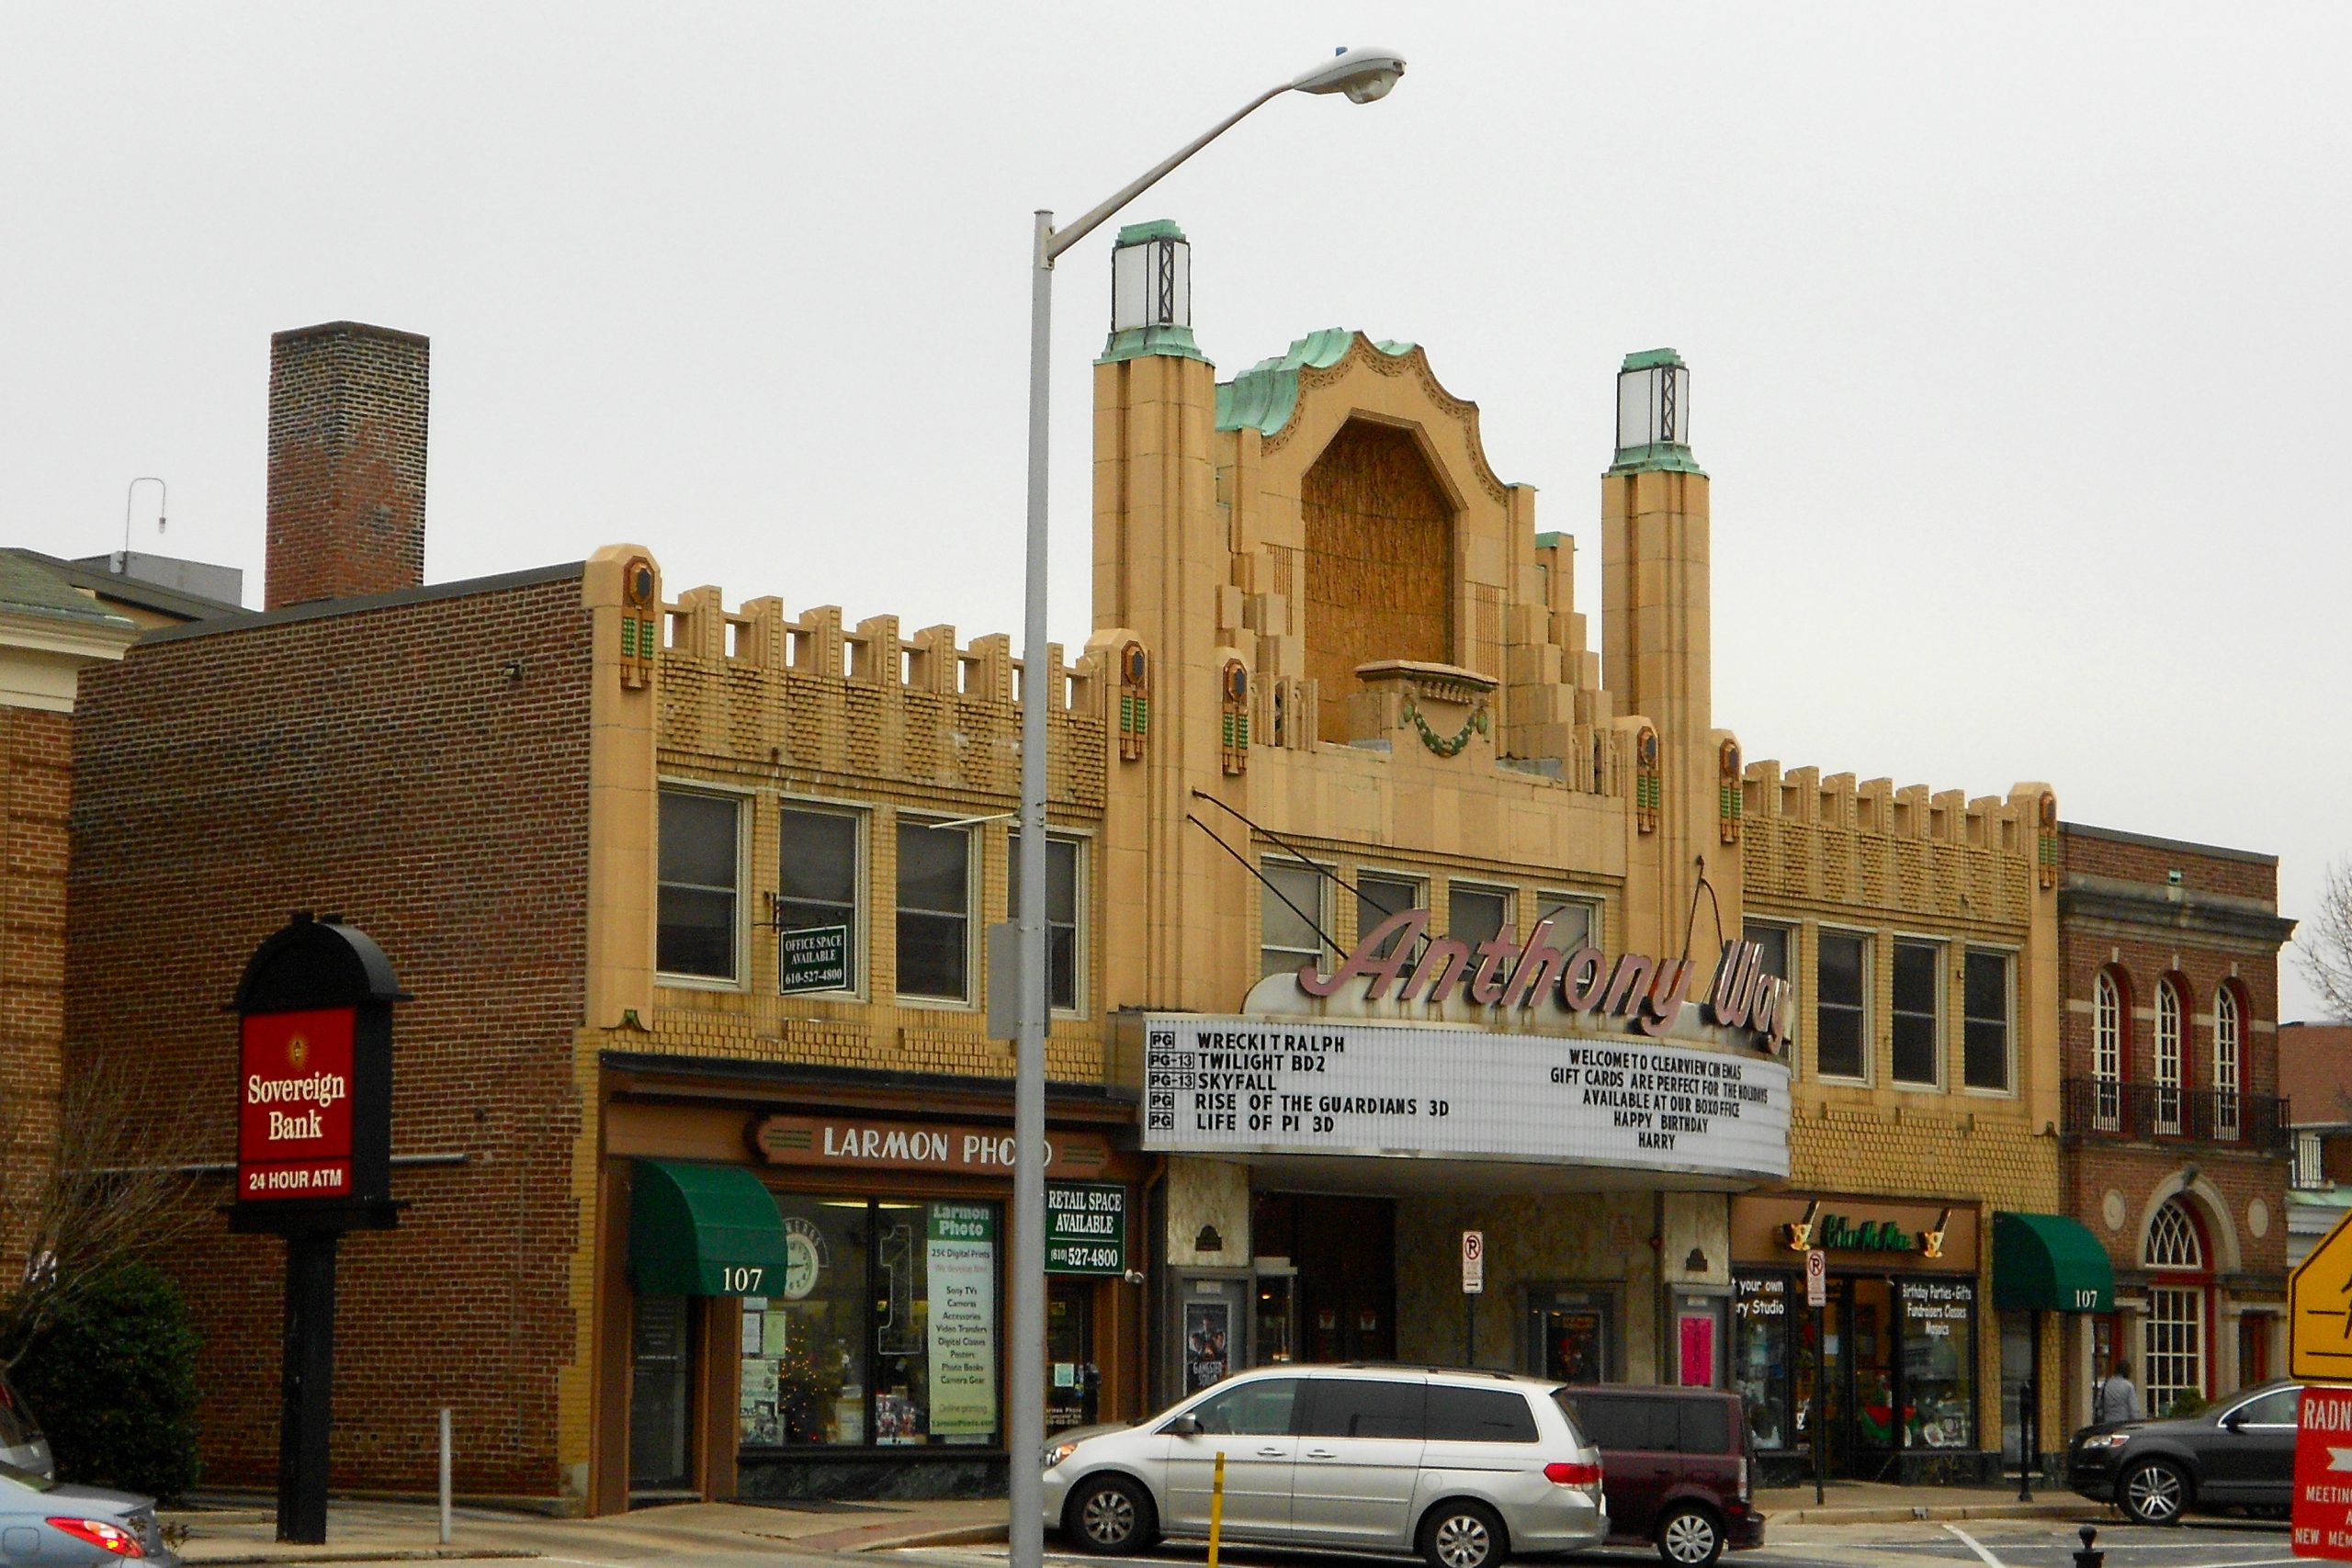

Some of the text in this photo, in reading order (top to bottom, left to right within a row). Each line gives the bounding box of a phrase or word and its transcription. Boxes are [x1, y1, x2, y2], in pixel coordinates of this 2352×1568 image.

[786, 935, 842, 952] OFFICE SPACE
[791, 949, 836, 964] AVAILABLE
[785, 968, 842, 985] 610-527-4800
[1297, 908, 1792, 1055] Anthony Way
[1151, 1034, 1172, 1046] PG
[1150, 1054, 1326, 1072] PG-13 TWILIGHT BD2
[248, 1071, 345, 1108] Sovereign
[1150, 1073, 1277, 1090] PG-13 SKYFALL
[1551, 1066, 1579, 1084] GIFT
[1585, 1069, 1624, 1088] CARDS
[1631, 1073, 1654, 1090] ARE
[1657, 1075, 1700, 1095] PERFECT
[1702, 1080, 1719, 1097] FOR
[1724, 1082, 1737, 1099] THE
[1151, 1093, 1449, 1116] PG RISE OF THE GUARDIANS 3D
[1583, 1089, 1650, 1109] AVAILABLE
[1654, 1095, 1668, 1111] AT
[1670, 1096, 1691, 1112] OUR
[268, 1109, 323, 1140] Bank
[1151, 1113, 1334, 1133] PG LIFE OF PI 3D
[1614, 1111, 1708, 1134] HAPPY BIRTHDAY
[823, 1127, 948, 1162] LARMON
[1638, 1132, 1676, 1150] HARRY
[249, 1168, 343, 1190] 24 HOUR ATM
[1048, 1190, 1122, 1212] RETAIL SPACE
[933, 1204, 989, 1220] Larmon
[939, 1220, 984, 1236] Photo
[1055, 1213, 1114, 1234] AVAILABLE
[947, 1249, 969, 1259] Digital
[971, 1249, 990, 1259] Prints
[1068, 1247, 1118, 1267] 527-4800
[724, 1267, 763, 1292] 107
[1739, 1280, 1762, 1296] your
[1765, 1280, 1784, 1292] own
[946, 1286, 978, 1297] Sony TVs
[1903, 1283, 1928, 1303] Birthday
[2076, 1289, 2098, 1308] 107
[947, 1299, 977, 1309] Cameras
[1752, 1299, 1785, 1315] Studio
[1907, 1302, 1943, 1318] Fundraisers
[943, 1312, 981, 1322] Accessories
[936, 1325, 956, 1334] Video
[938, 1337, 961, 1348] Digital
[942, 1363, 962, 1372] Photo
[941, 1376, 967, 1385] Camera
[2295, 1529, 2320, 1544] NEW
